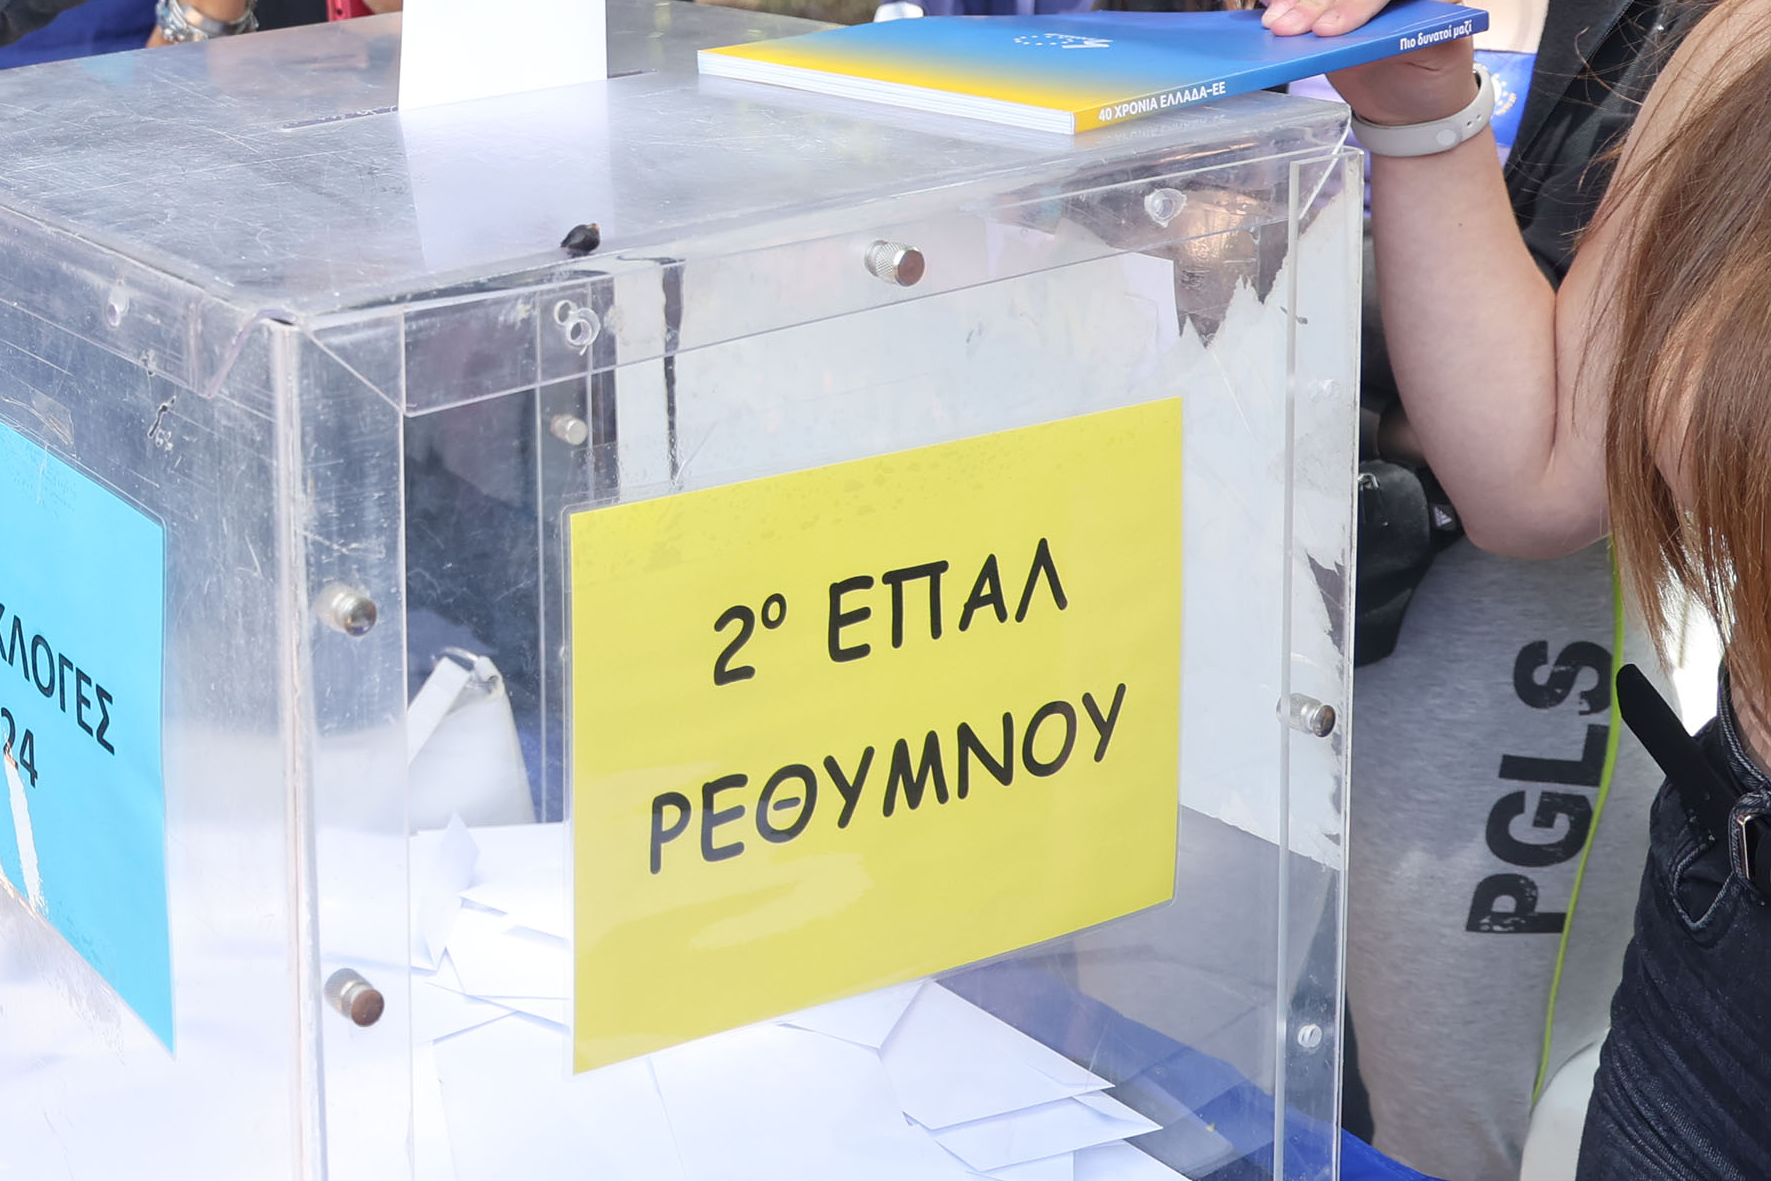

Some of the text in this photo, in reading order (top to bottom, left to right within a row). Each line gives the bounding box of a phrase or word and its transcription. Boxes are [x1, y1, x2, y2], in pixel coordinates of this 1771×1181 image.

[1399, 19, 1473, 50] Πιο δυνατοί μαζί
[1098, 106, 1113, 121] 40
[1114, 97, 1159, 119] ΧΡΟΝΙΑ
[827, 537, 1068, 663] ΕΠΑΛ
[648, 682, 1127, 875] ΡΕΘΥΜΝΟΥ
[1465, 640, 1614, 934] PGLS
